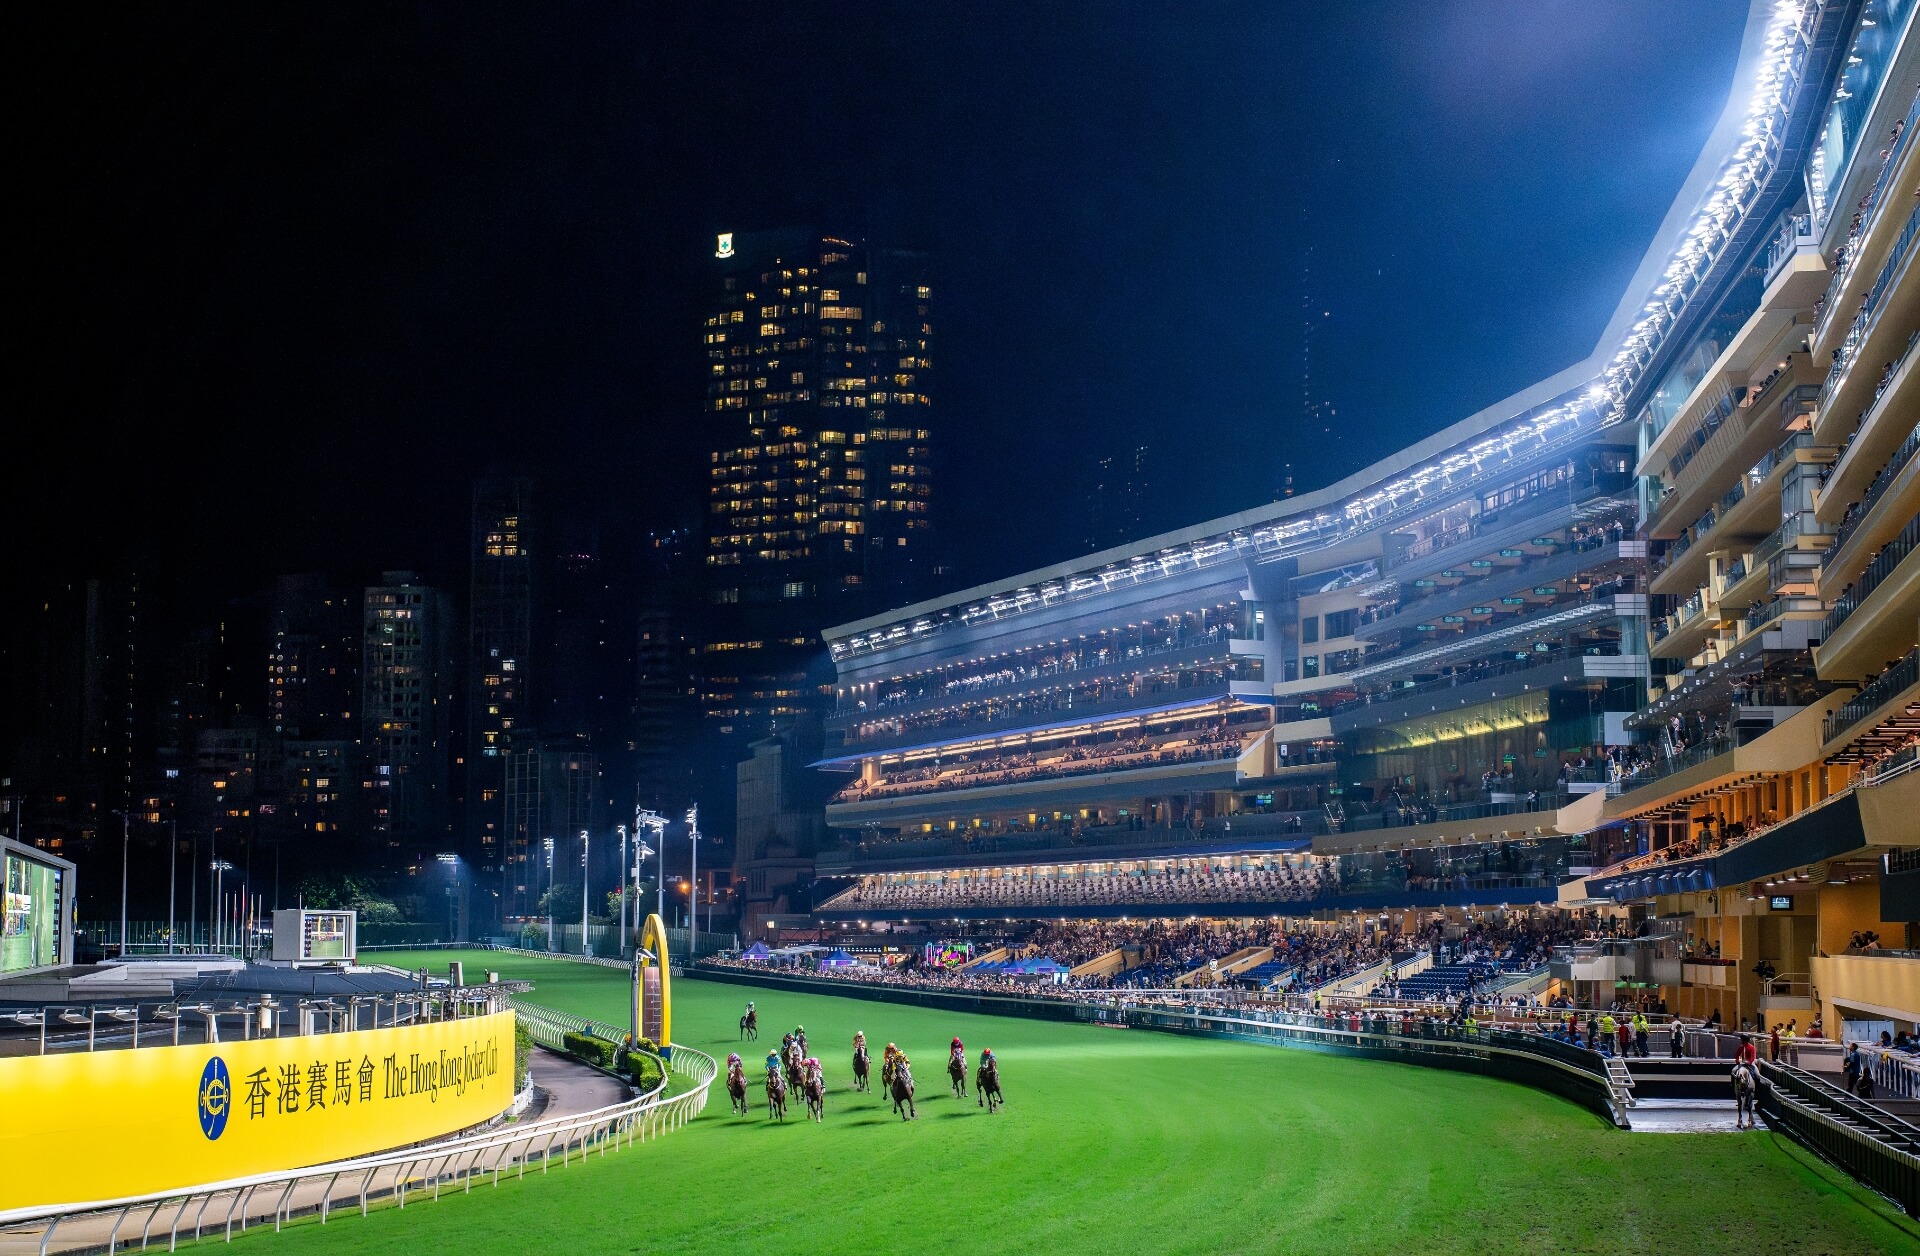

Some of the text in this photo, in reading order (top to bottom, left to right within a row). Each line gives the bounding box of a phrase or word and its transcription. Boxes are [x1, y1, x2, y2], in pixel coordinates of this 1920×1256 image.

[244, 1054, 375, 1120] 香港賽馬會
[383, 1052, 407, 1099] The
[410, 1053, 438, 1103] Hong
[439, 1049, 462, 1097] Kong
[462, 1040, 486, 1094] Jockey
